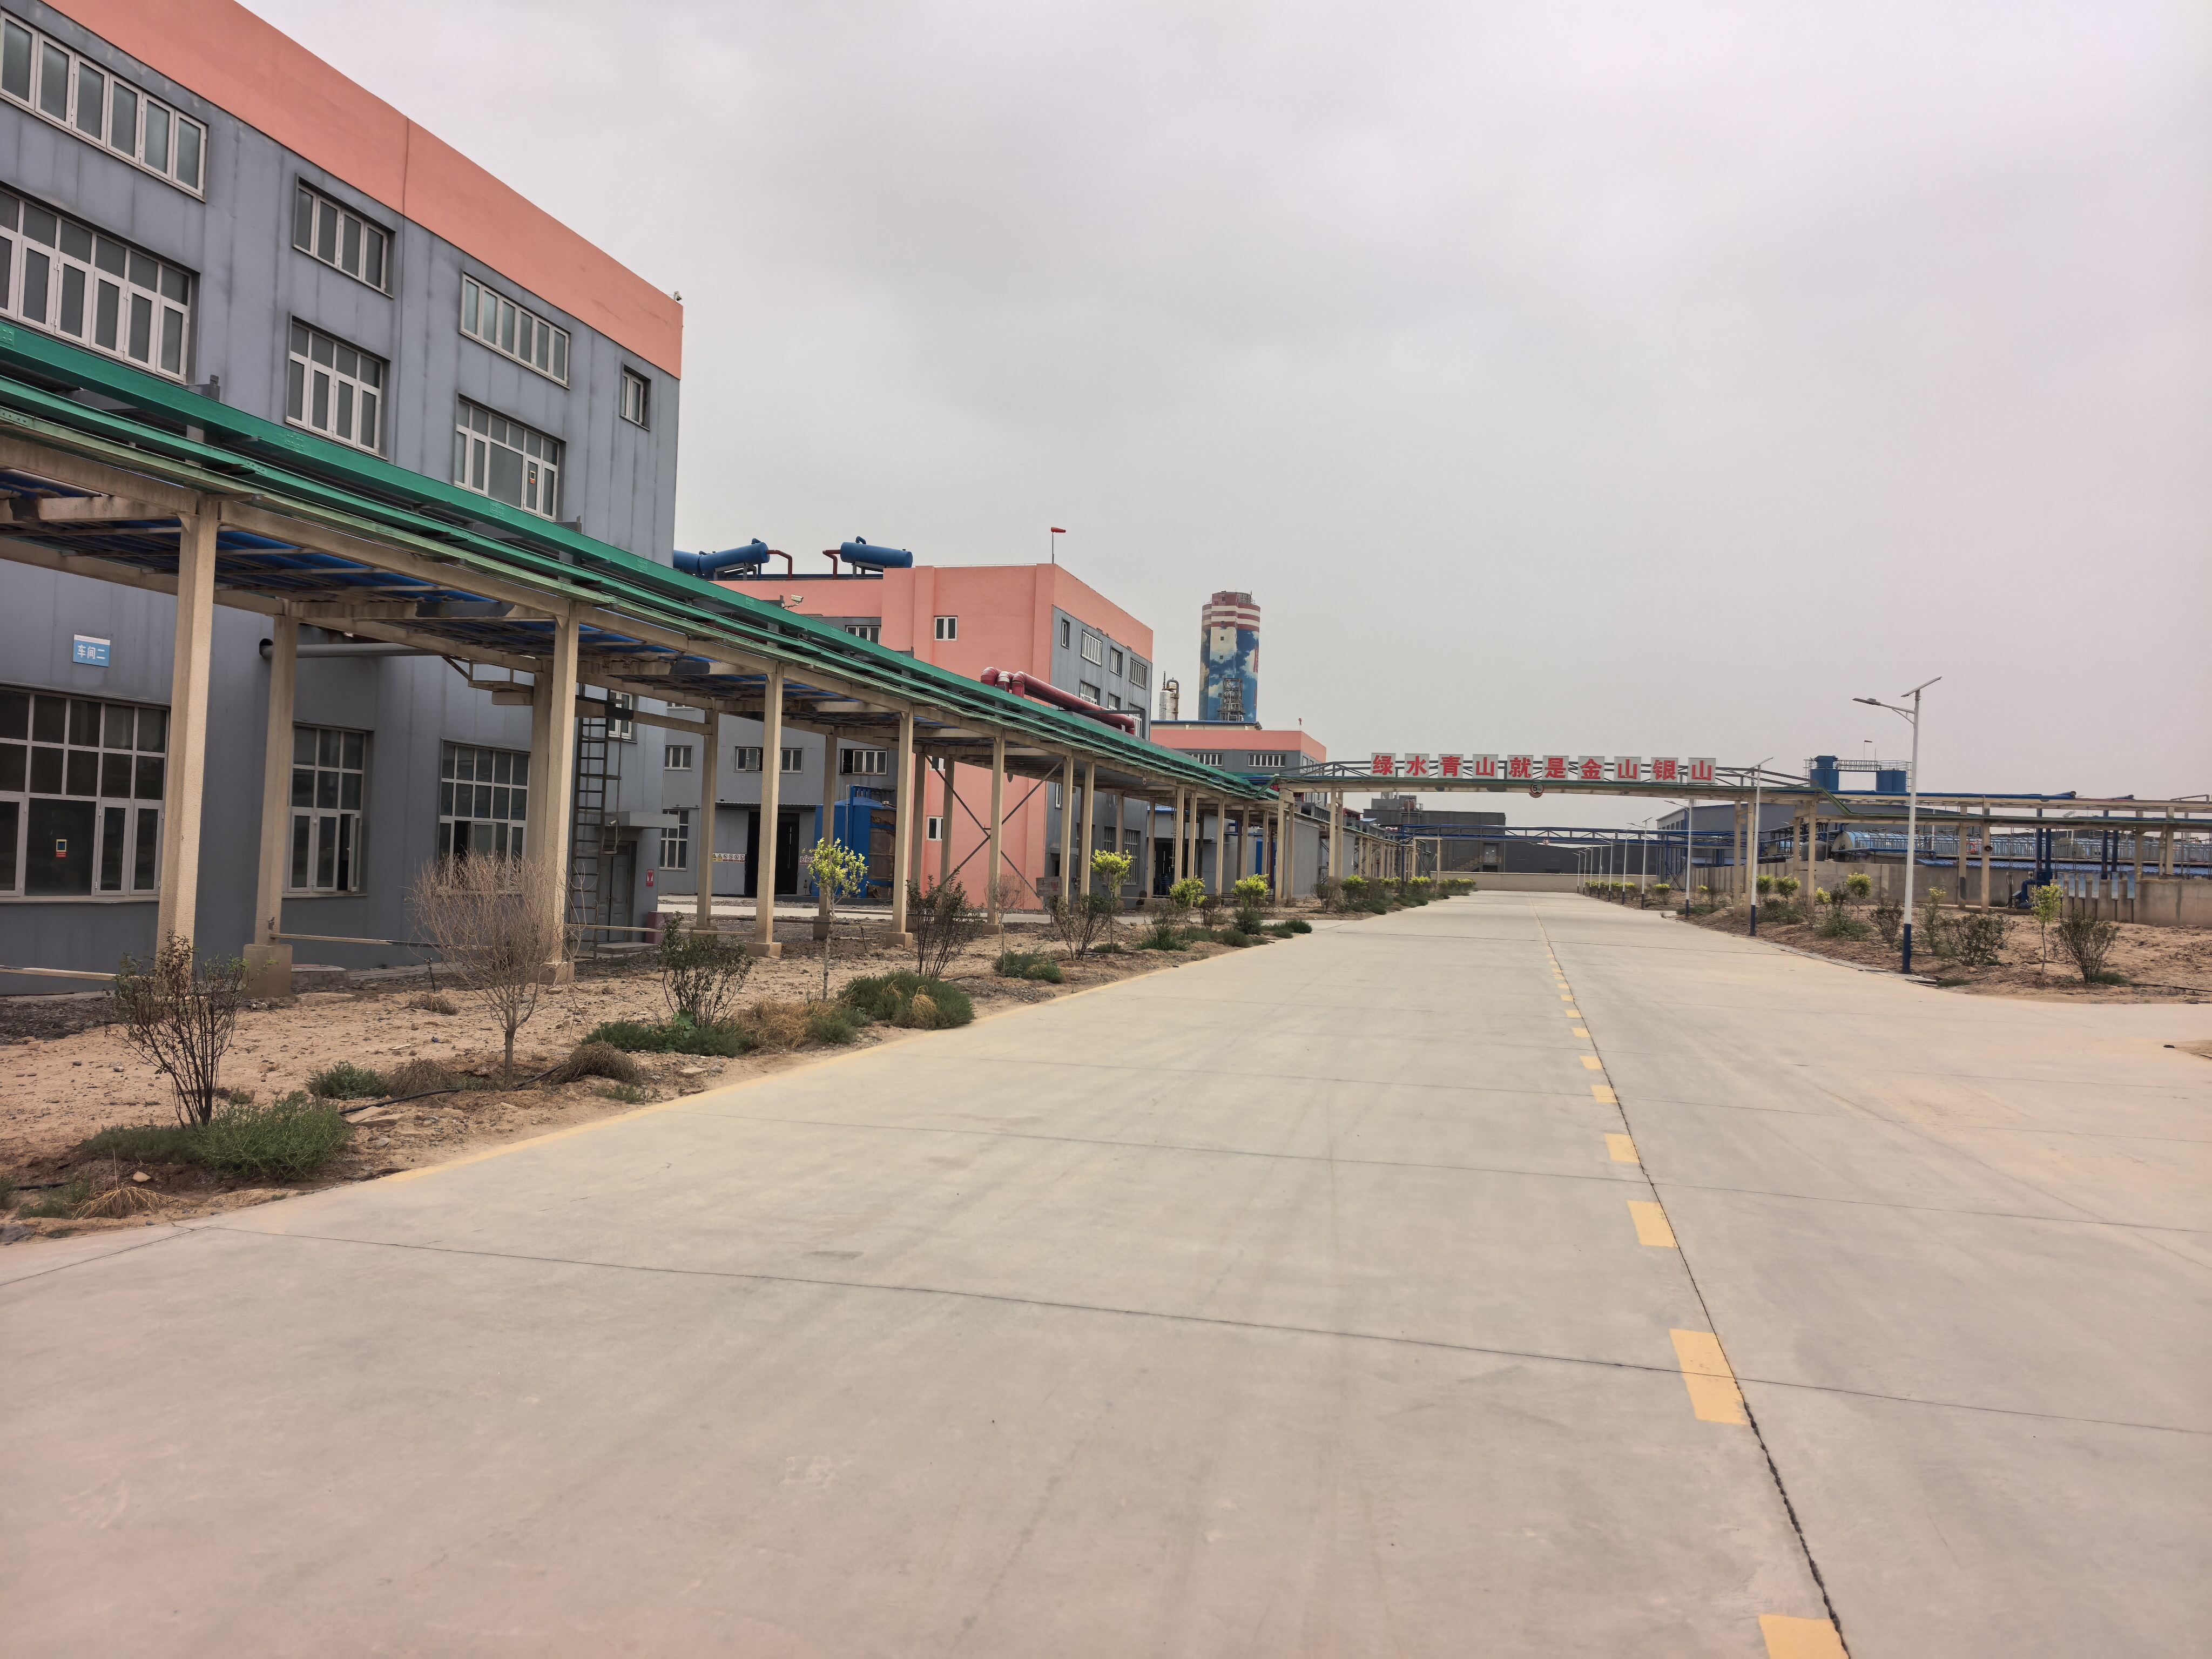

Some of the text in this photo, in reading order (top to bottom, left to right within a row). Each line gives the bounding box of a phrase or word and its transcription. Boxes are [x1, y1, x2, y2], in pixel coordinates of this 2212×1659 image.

[77, 644, 106, 659] 车间二
[1372, 754, 1712, 781] 绿水青山就是金山银山
